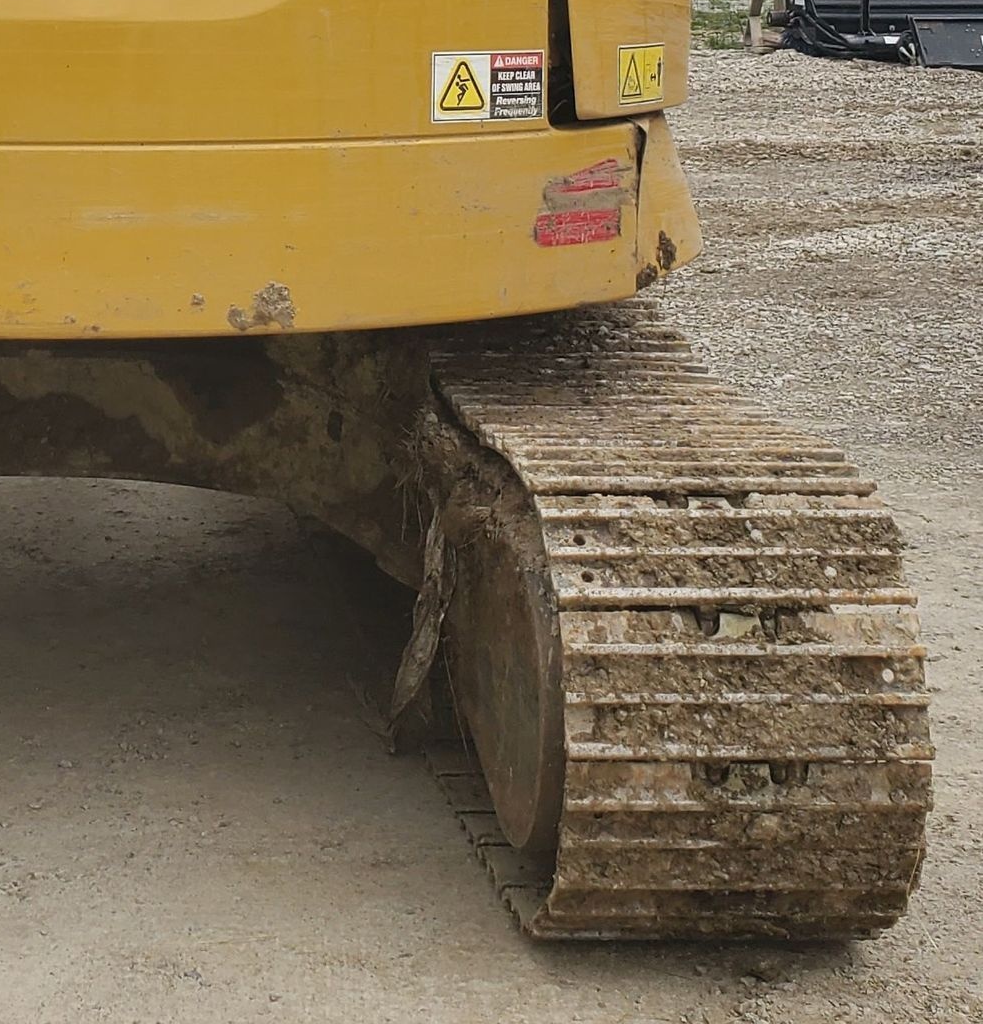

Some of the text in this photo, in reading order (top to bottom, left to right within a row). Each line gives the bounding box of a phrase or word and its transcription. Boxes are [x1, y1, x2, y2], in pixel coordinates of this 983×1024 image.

[505, 56, 538, 66] DANGER
[498, 71, 536, 81] KEEP CLEAR
[492, 82, 541, 92] OF SWING AREA
[496, 96, 537, 106] Reversing
[494, 106, 538, 117] Frequently
